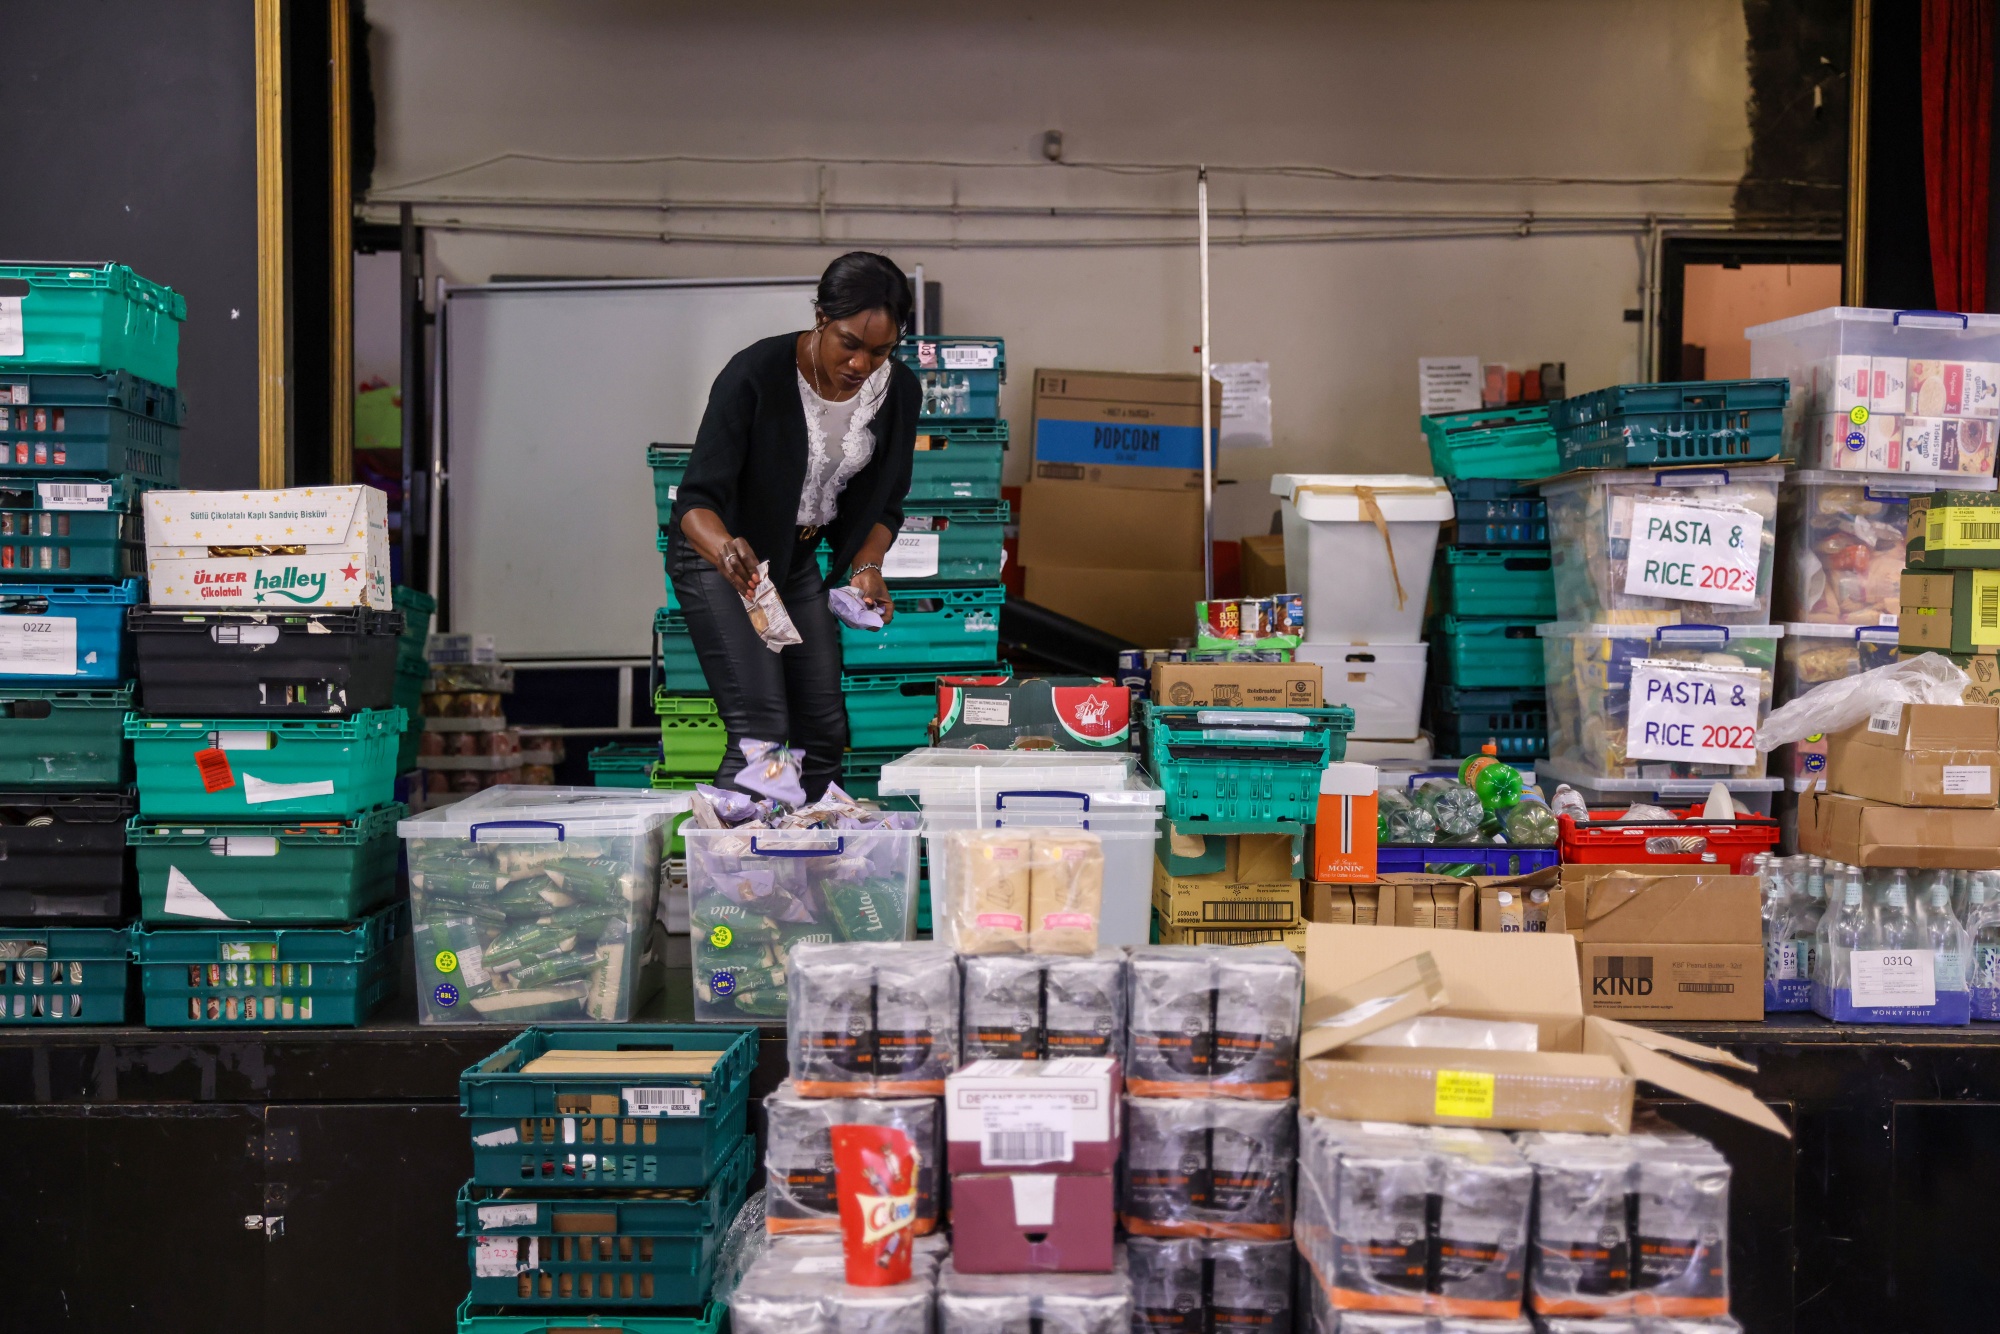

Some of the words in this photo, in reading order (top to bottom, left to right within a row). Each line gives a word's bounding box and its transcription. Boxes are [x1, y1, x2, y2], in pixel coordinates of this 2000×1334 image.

[1094, 426, 1160, 452] POPCORN
[190, 510, 209, 520] Sütlü
[210, 511, 246, 521] Çikolatalı
[247, 511, 267, 520] Kaplı
[269, 511, 298, 520] Sandviç
[300, 510, 327, 518] Bisküvi
[1648, 517, 1712, 546] PASTA
[1728, 525, 1743, 548] &
[193, 570, 247, 585] ÜLKER
[253, 566, 326, 604] halley
[1644, 560, 1694, 586] RICE
[1700, 565, 1755, 592] 2023
[200, 586, 242, 600] Çikolatalı
[23, 622, 52, 633] 02ZZ
[1647, 679, 1716, 706] PASTA
[1730, 684, 1746, 706] &
[1645, 721, 1695, 746] RICE
[1702, 725, 1755, 748] 2022
[859, 890, 883, 932] Laila
[1883, 956, 1913, 966] 031Q
[1593, 977, 1653, 996] KIND
